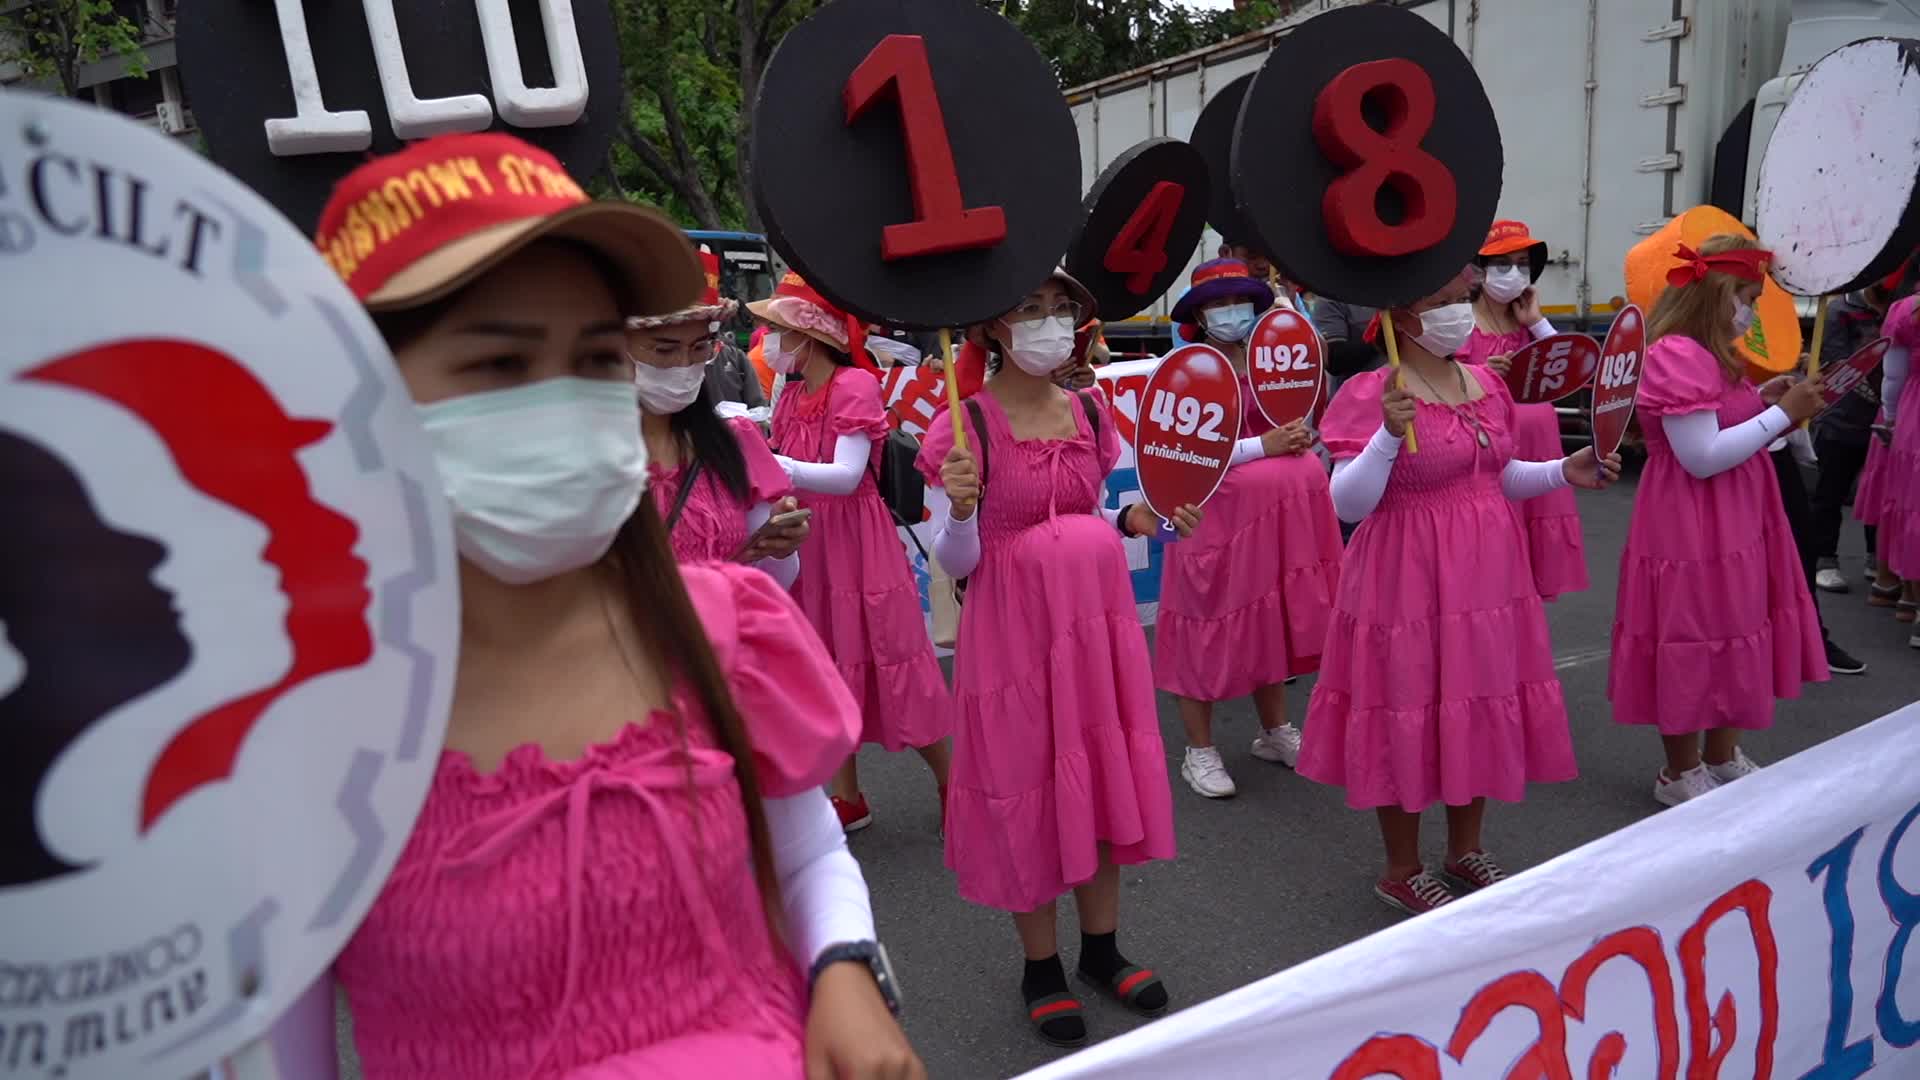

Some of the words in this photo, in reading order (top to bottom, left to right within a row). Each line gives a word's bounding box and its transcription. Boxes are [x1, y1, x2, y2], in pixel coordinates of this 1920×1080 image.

[842, 34, 1006, 260] 1
[1313, 57, 1457, 257] 8
[29, 150, 222, 278] CILT
[1104, 180, 1185, 295] 4
[1255, 343, 1308, 373] 492
[1540, 340, 1573, 394] 492
[1600, 351, 1637, 390] 492
[1149, 388, 1225, 442] 492
